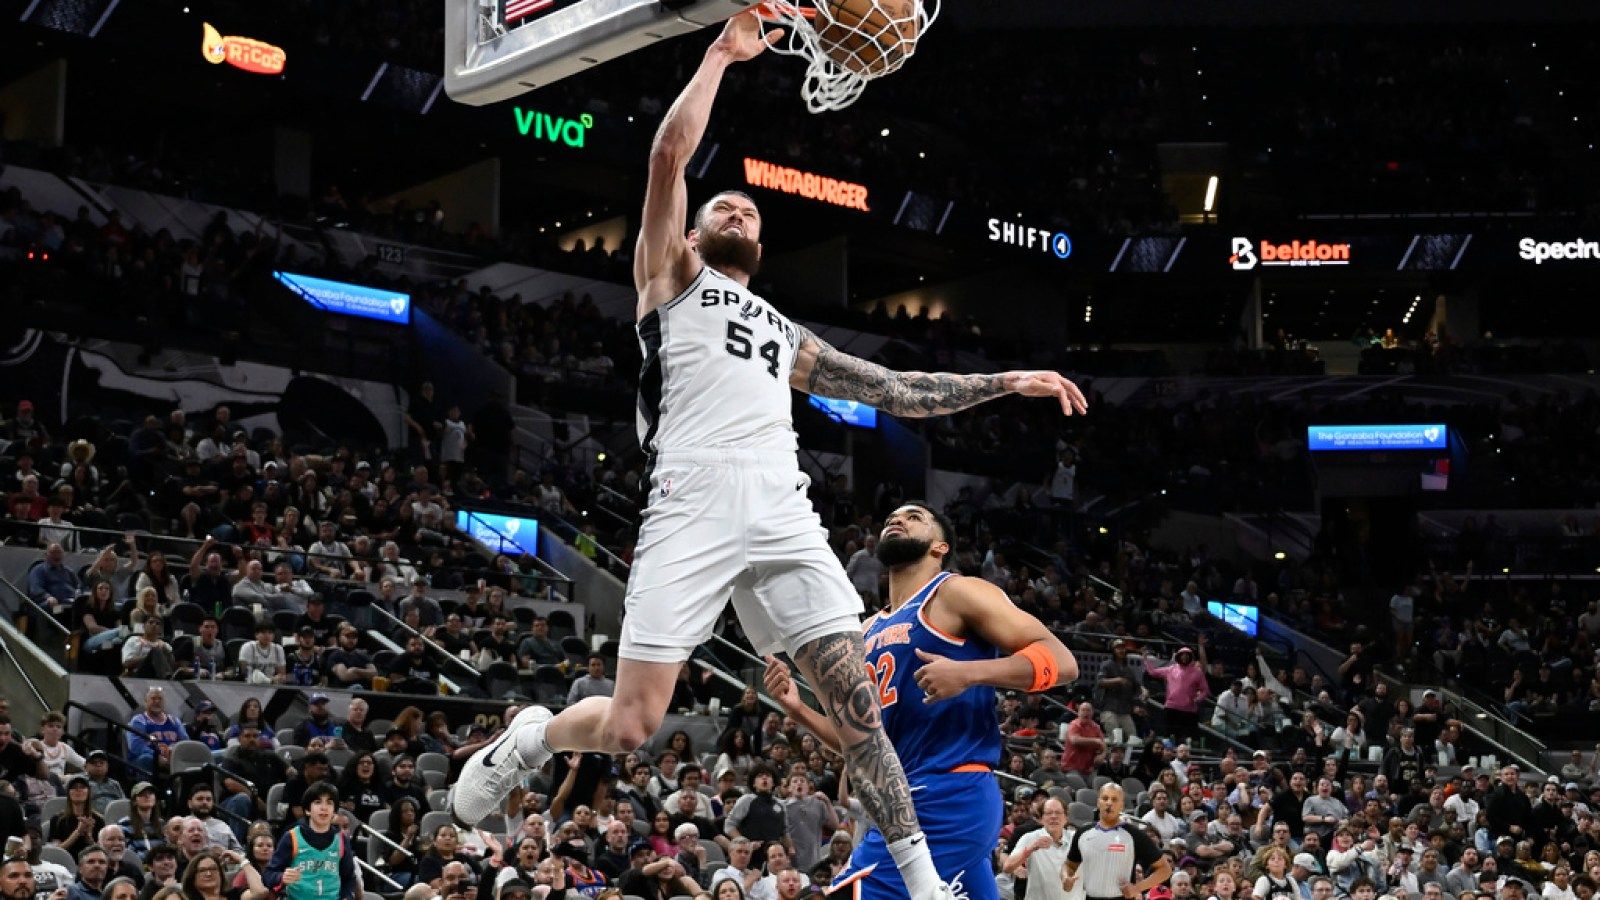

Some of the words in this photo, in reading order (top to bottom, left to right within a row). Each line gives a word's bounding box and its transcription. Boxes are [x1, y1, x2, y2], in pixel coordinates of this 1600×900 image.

[743, 157, 870, 212] WHATABURGER
[988, 218, 1051, 252] SHIFT
[1260, 240, 1349, 260] beldon
[700, 288, 795, 350] SPURS
[724, 320, 780, 378] 54
[1376, 431, 1424, 440] Foundation
[316, 879, 324, 896] 1
